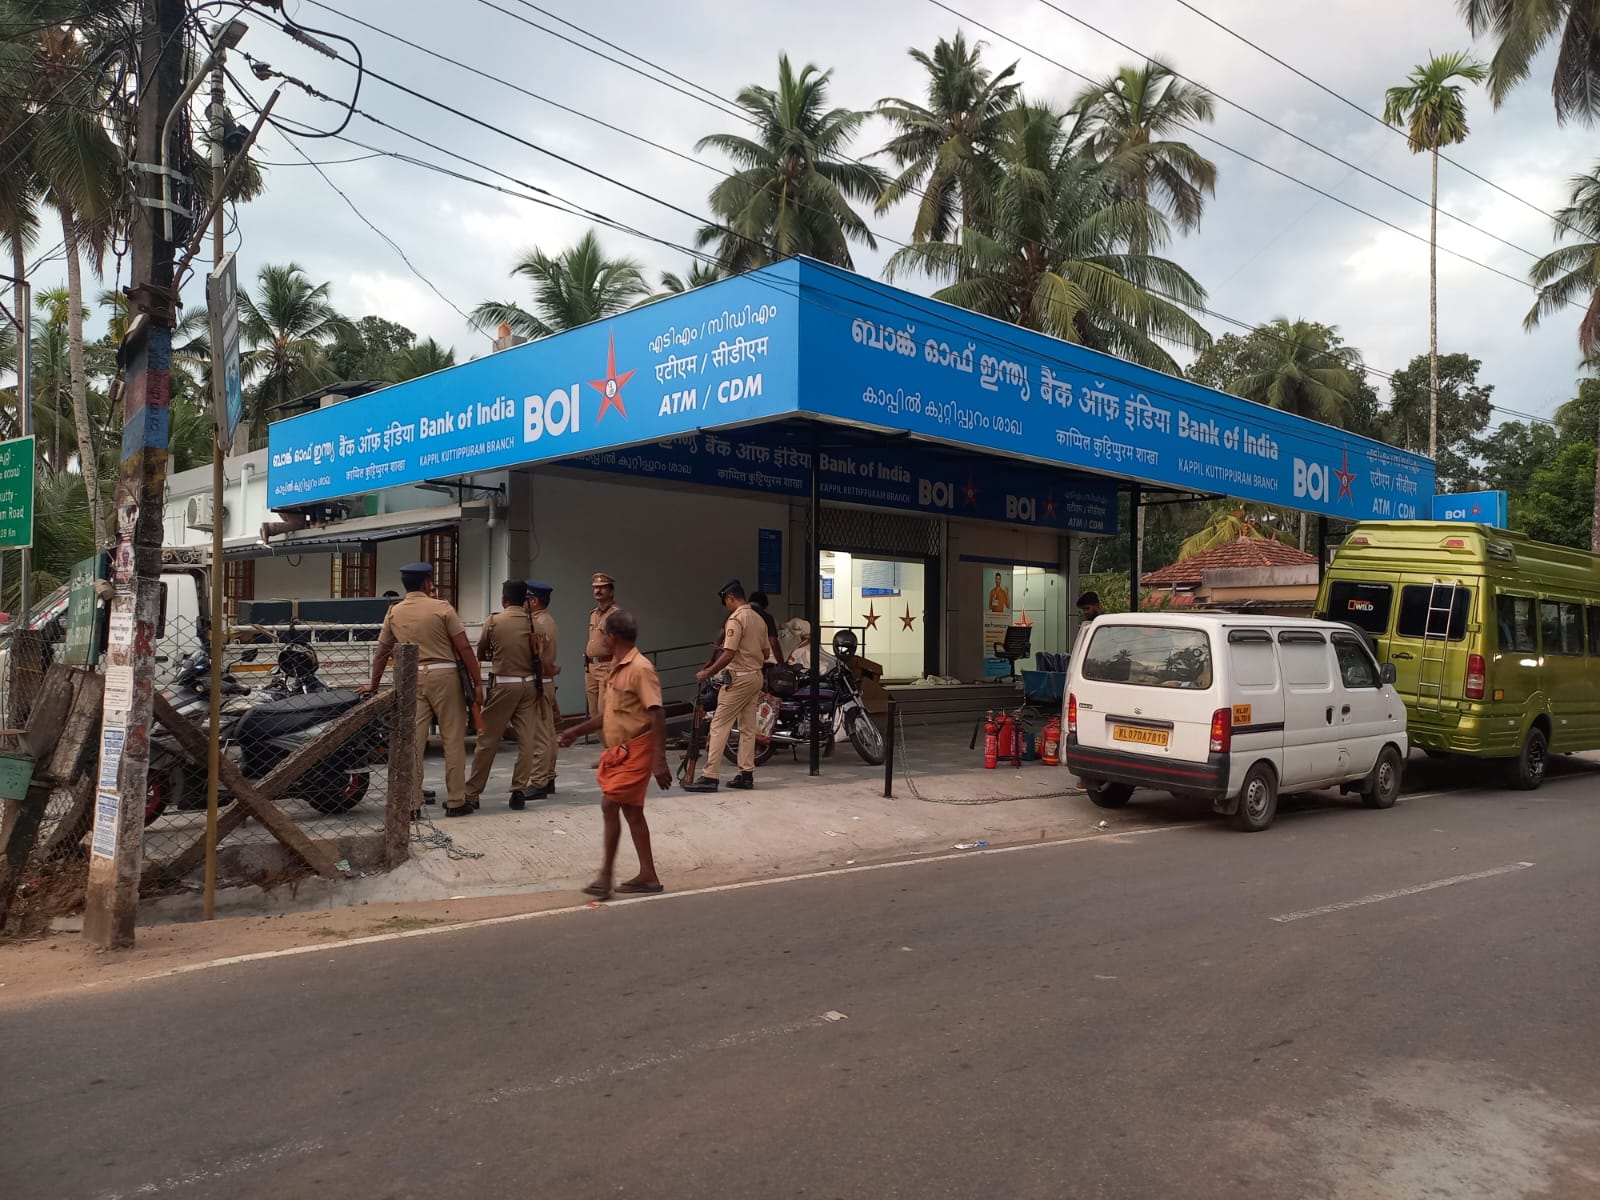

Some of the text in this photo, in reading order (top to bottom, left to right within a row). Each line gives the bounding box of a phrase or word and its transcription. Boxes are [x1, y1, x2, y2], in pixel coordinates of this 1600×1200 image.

[655, 354, 697, 384] एटीएम
[711, 337, 769, 369] सीडीएम
[924, 338, 976, 374] ഓഫ്
[980, 354, 1031, 401] ഇന്ത്യ
[658, 388, 697, 417] ATM
[717, 373, 763, 404] CDM
[1040, 364, 1073, 409] बैंक
[1124, 393, 1171, 434] इंडिया
[420, 396, 515, 439] Bank of India
[523, 383, 580, 444] BOI
[338, 434, 355, 458] बैंक
[384, 421, 415, 452] इंडिया
[419, 436, 515, 467] KAPPIL KUTTIPPURAM BRANCH
[1178, 410, 1279, 461] Bank of India
[819, 453, 911, 483] Bank of India
[1136, 447, 1159, 466] शाखा
[1178, 457, 1279, 492] KAPPIL KUTTIPPURAM BRANCH
[1293, 457, 1329, 504] BOI
[819, 482, 842, 495] KAPPIL
[886, 490, 911, 504] BRANCH
[918, 478, 954, 509] BOI
[1006, 494, 1037, 522] BOI
[1372, 497, 1390, 516] ATM
[1398, 502, 1416, 520] CDM
[1067, 517, 1083, 528] ATM
[1088, 519, 1104, 530] CDM
[1445, 508, 1466, 520] BOI
[1355, 603, 1374, 612] WILD
